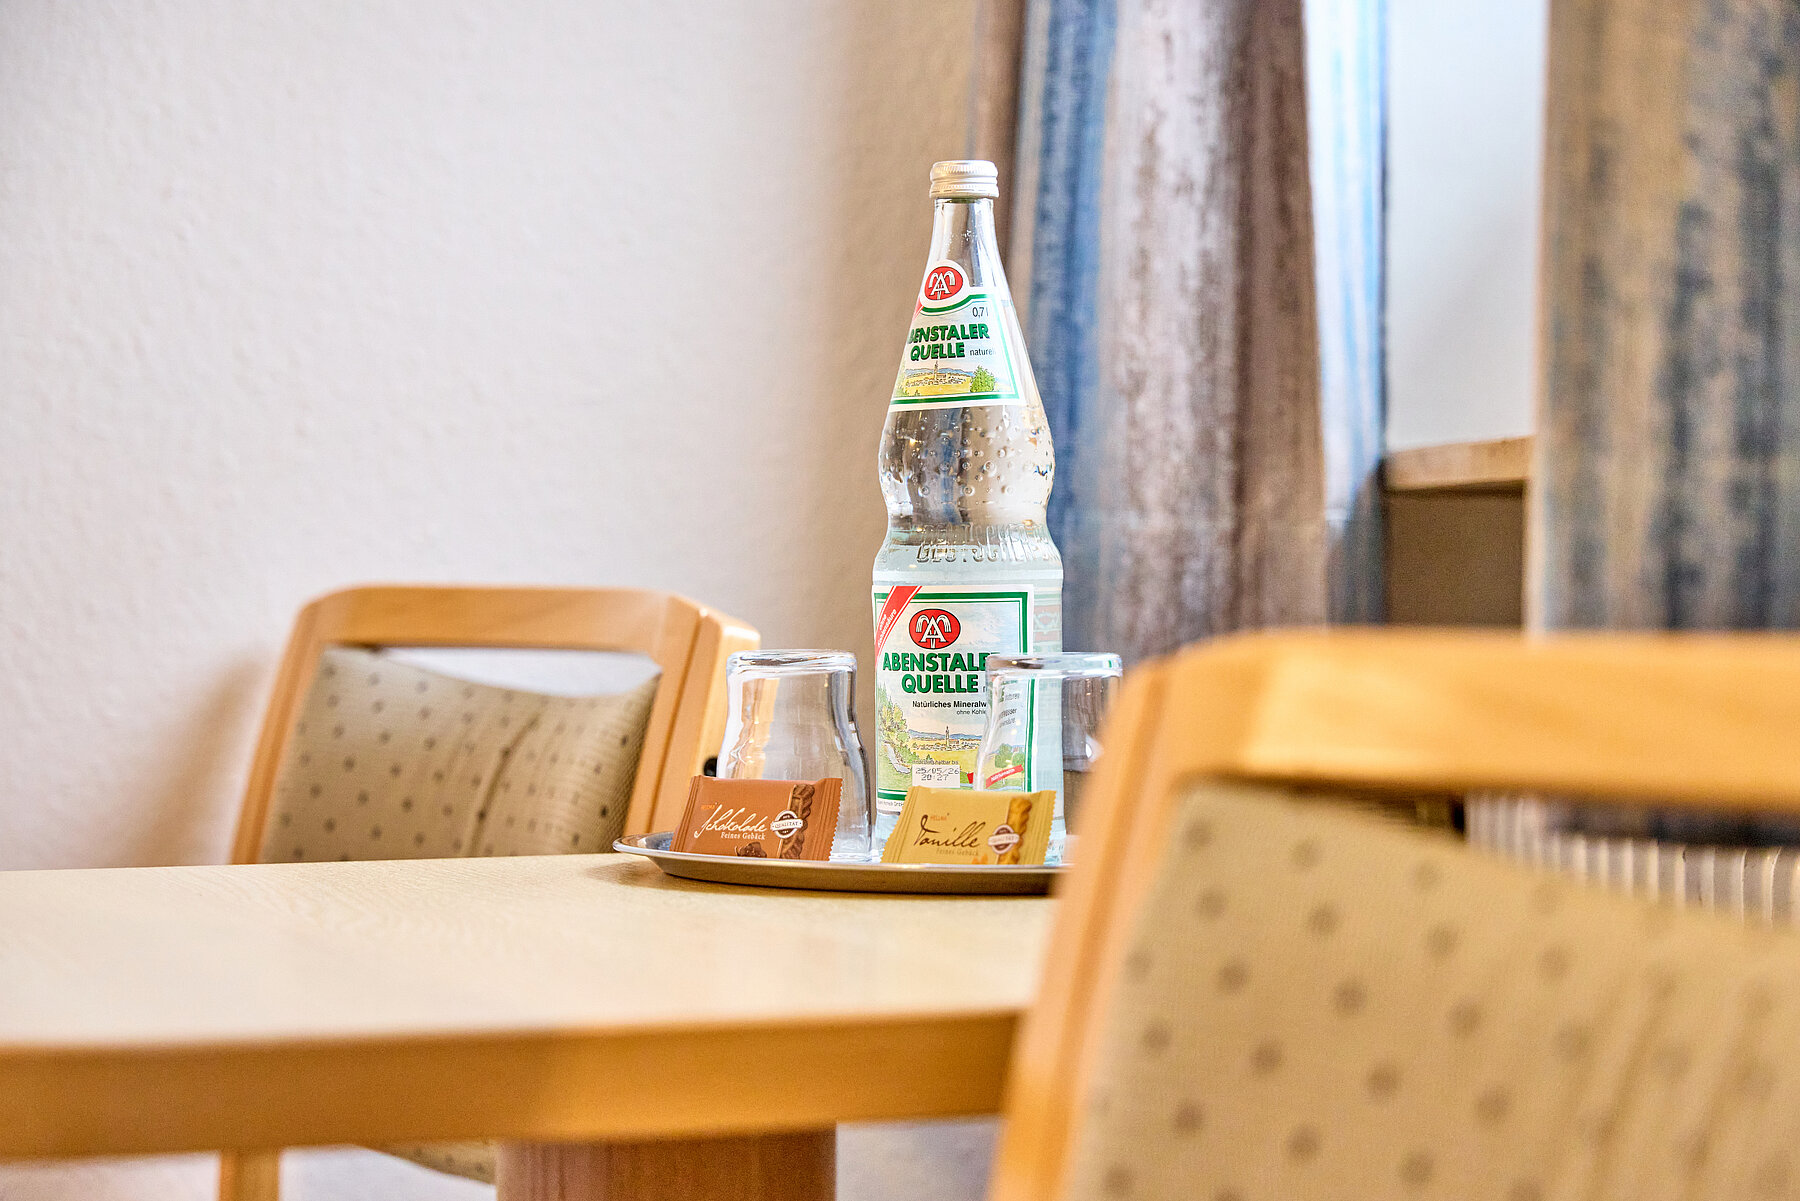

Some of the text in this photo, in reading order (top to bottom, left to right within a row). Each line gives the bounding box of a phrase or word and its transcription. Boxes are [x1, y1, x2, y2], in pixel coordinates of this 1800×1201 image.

[972, 307, 984, 318] 0,7
[910, 342, 966, 362] QUELLE
[883, 652, 998, 671] ABENSTALE
[901, 674, 979, 693] QUELLE
[912, 700, 951, 708] Natürliches
[694, 804, 769, 839] Schokolade
[913, 814, 986, 848] Vanille
[720, 831, 741, 839] Feines
